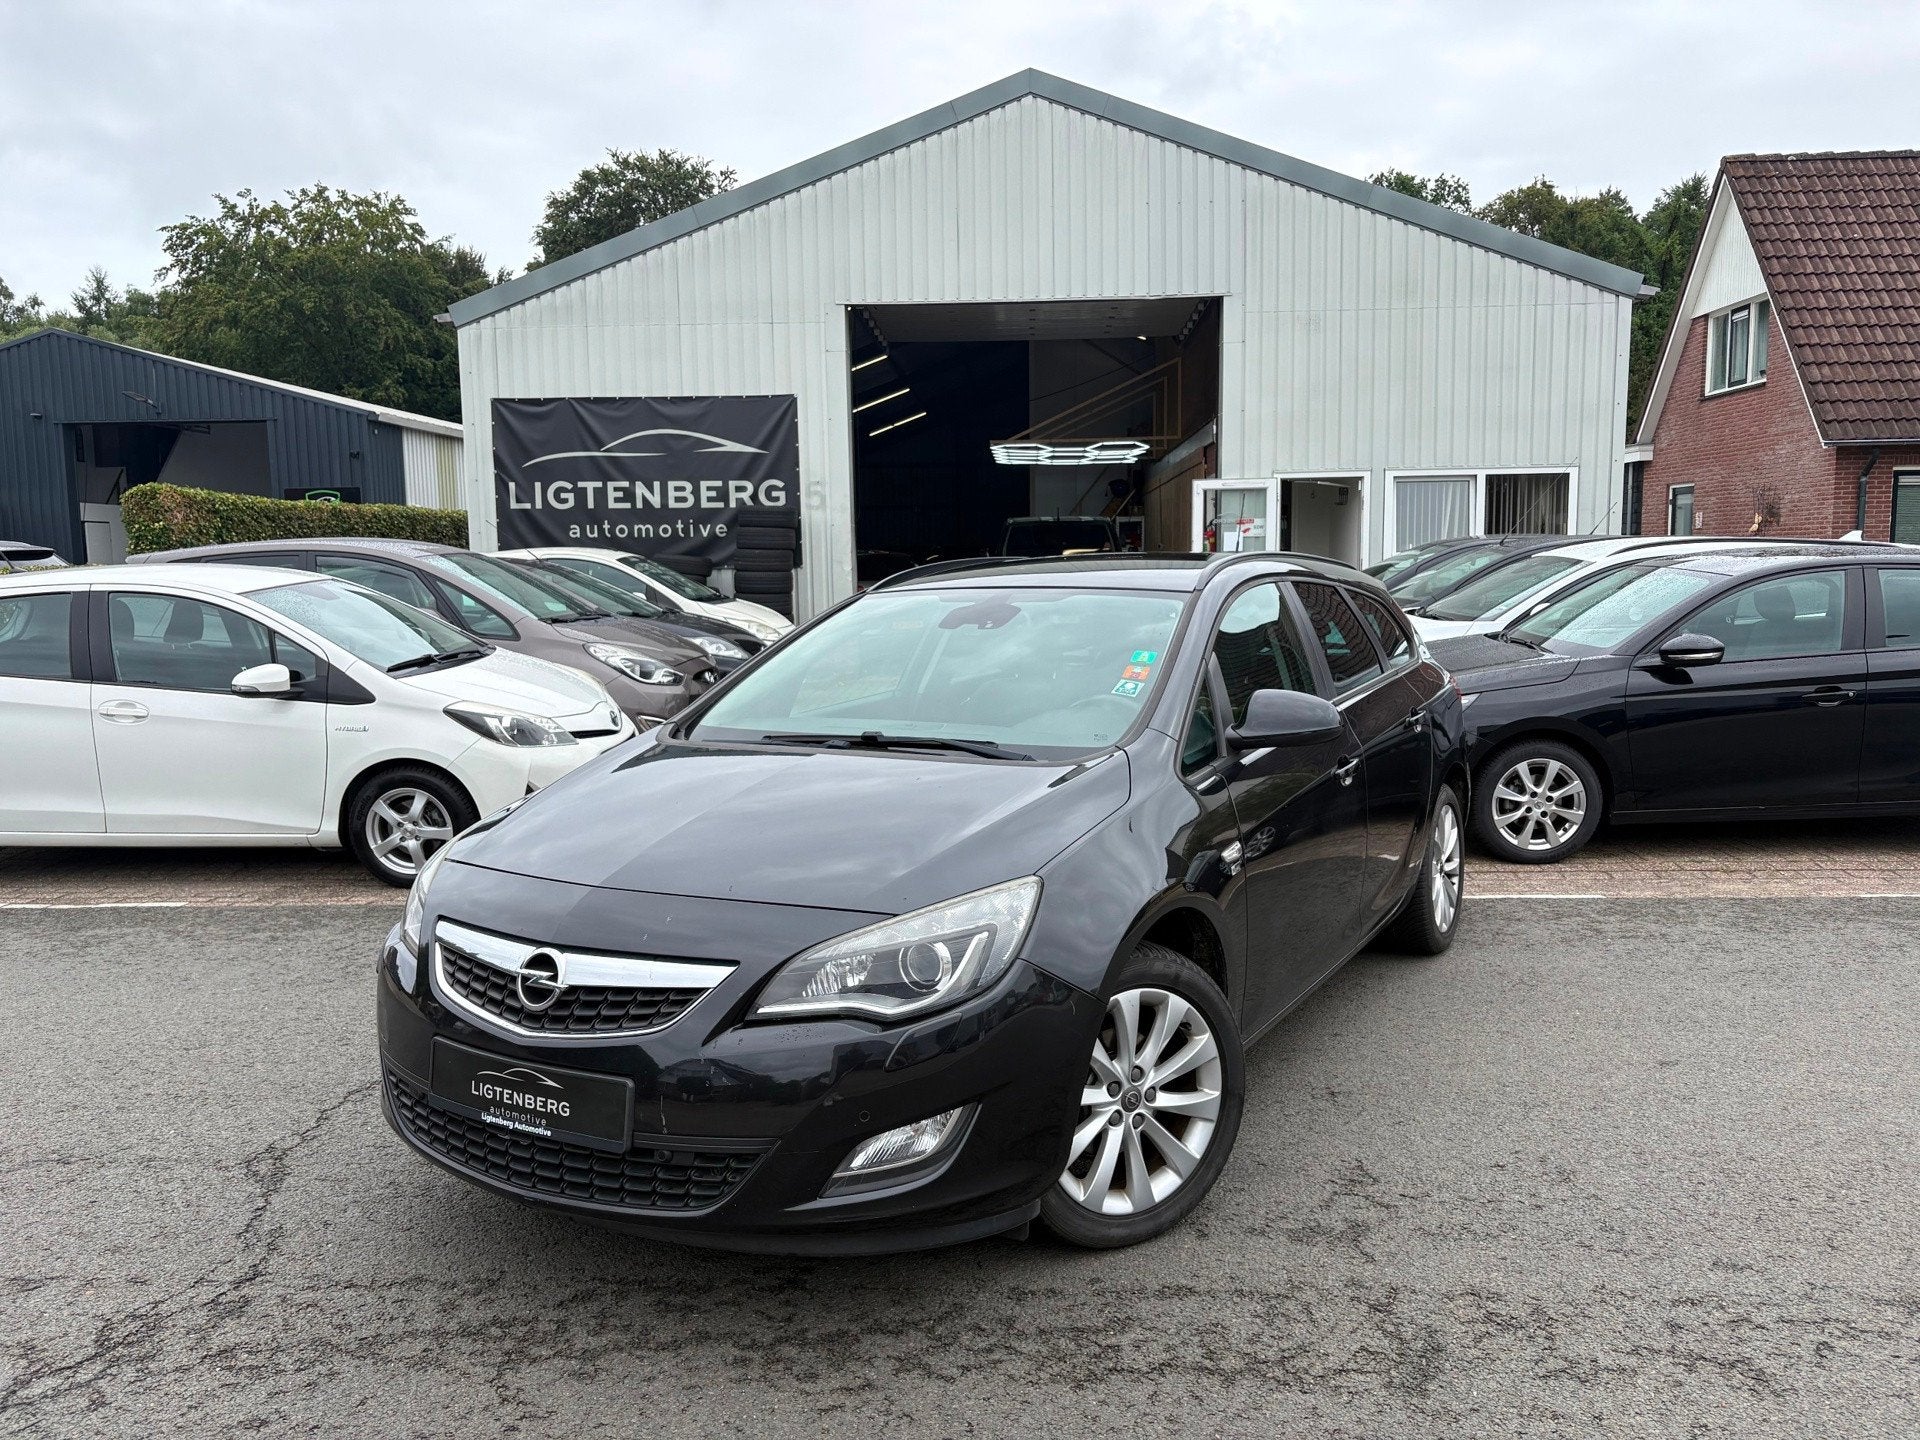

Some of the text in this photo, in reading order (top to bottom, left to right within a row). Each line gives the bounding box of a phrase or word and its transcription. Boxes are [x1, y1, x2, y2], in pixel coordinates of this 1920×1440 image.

[508, 479, 787, 510] LIGTENBERG
[805, 481, 827, 510] 5
[569, 519, 728, 538] automotive
[471, 1080, 570, 1117] LIGTENBERG
[481, 1111, 552, 1137] Ligtenberg Automotive
[489, 1105, 547, 1127] automotive
